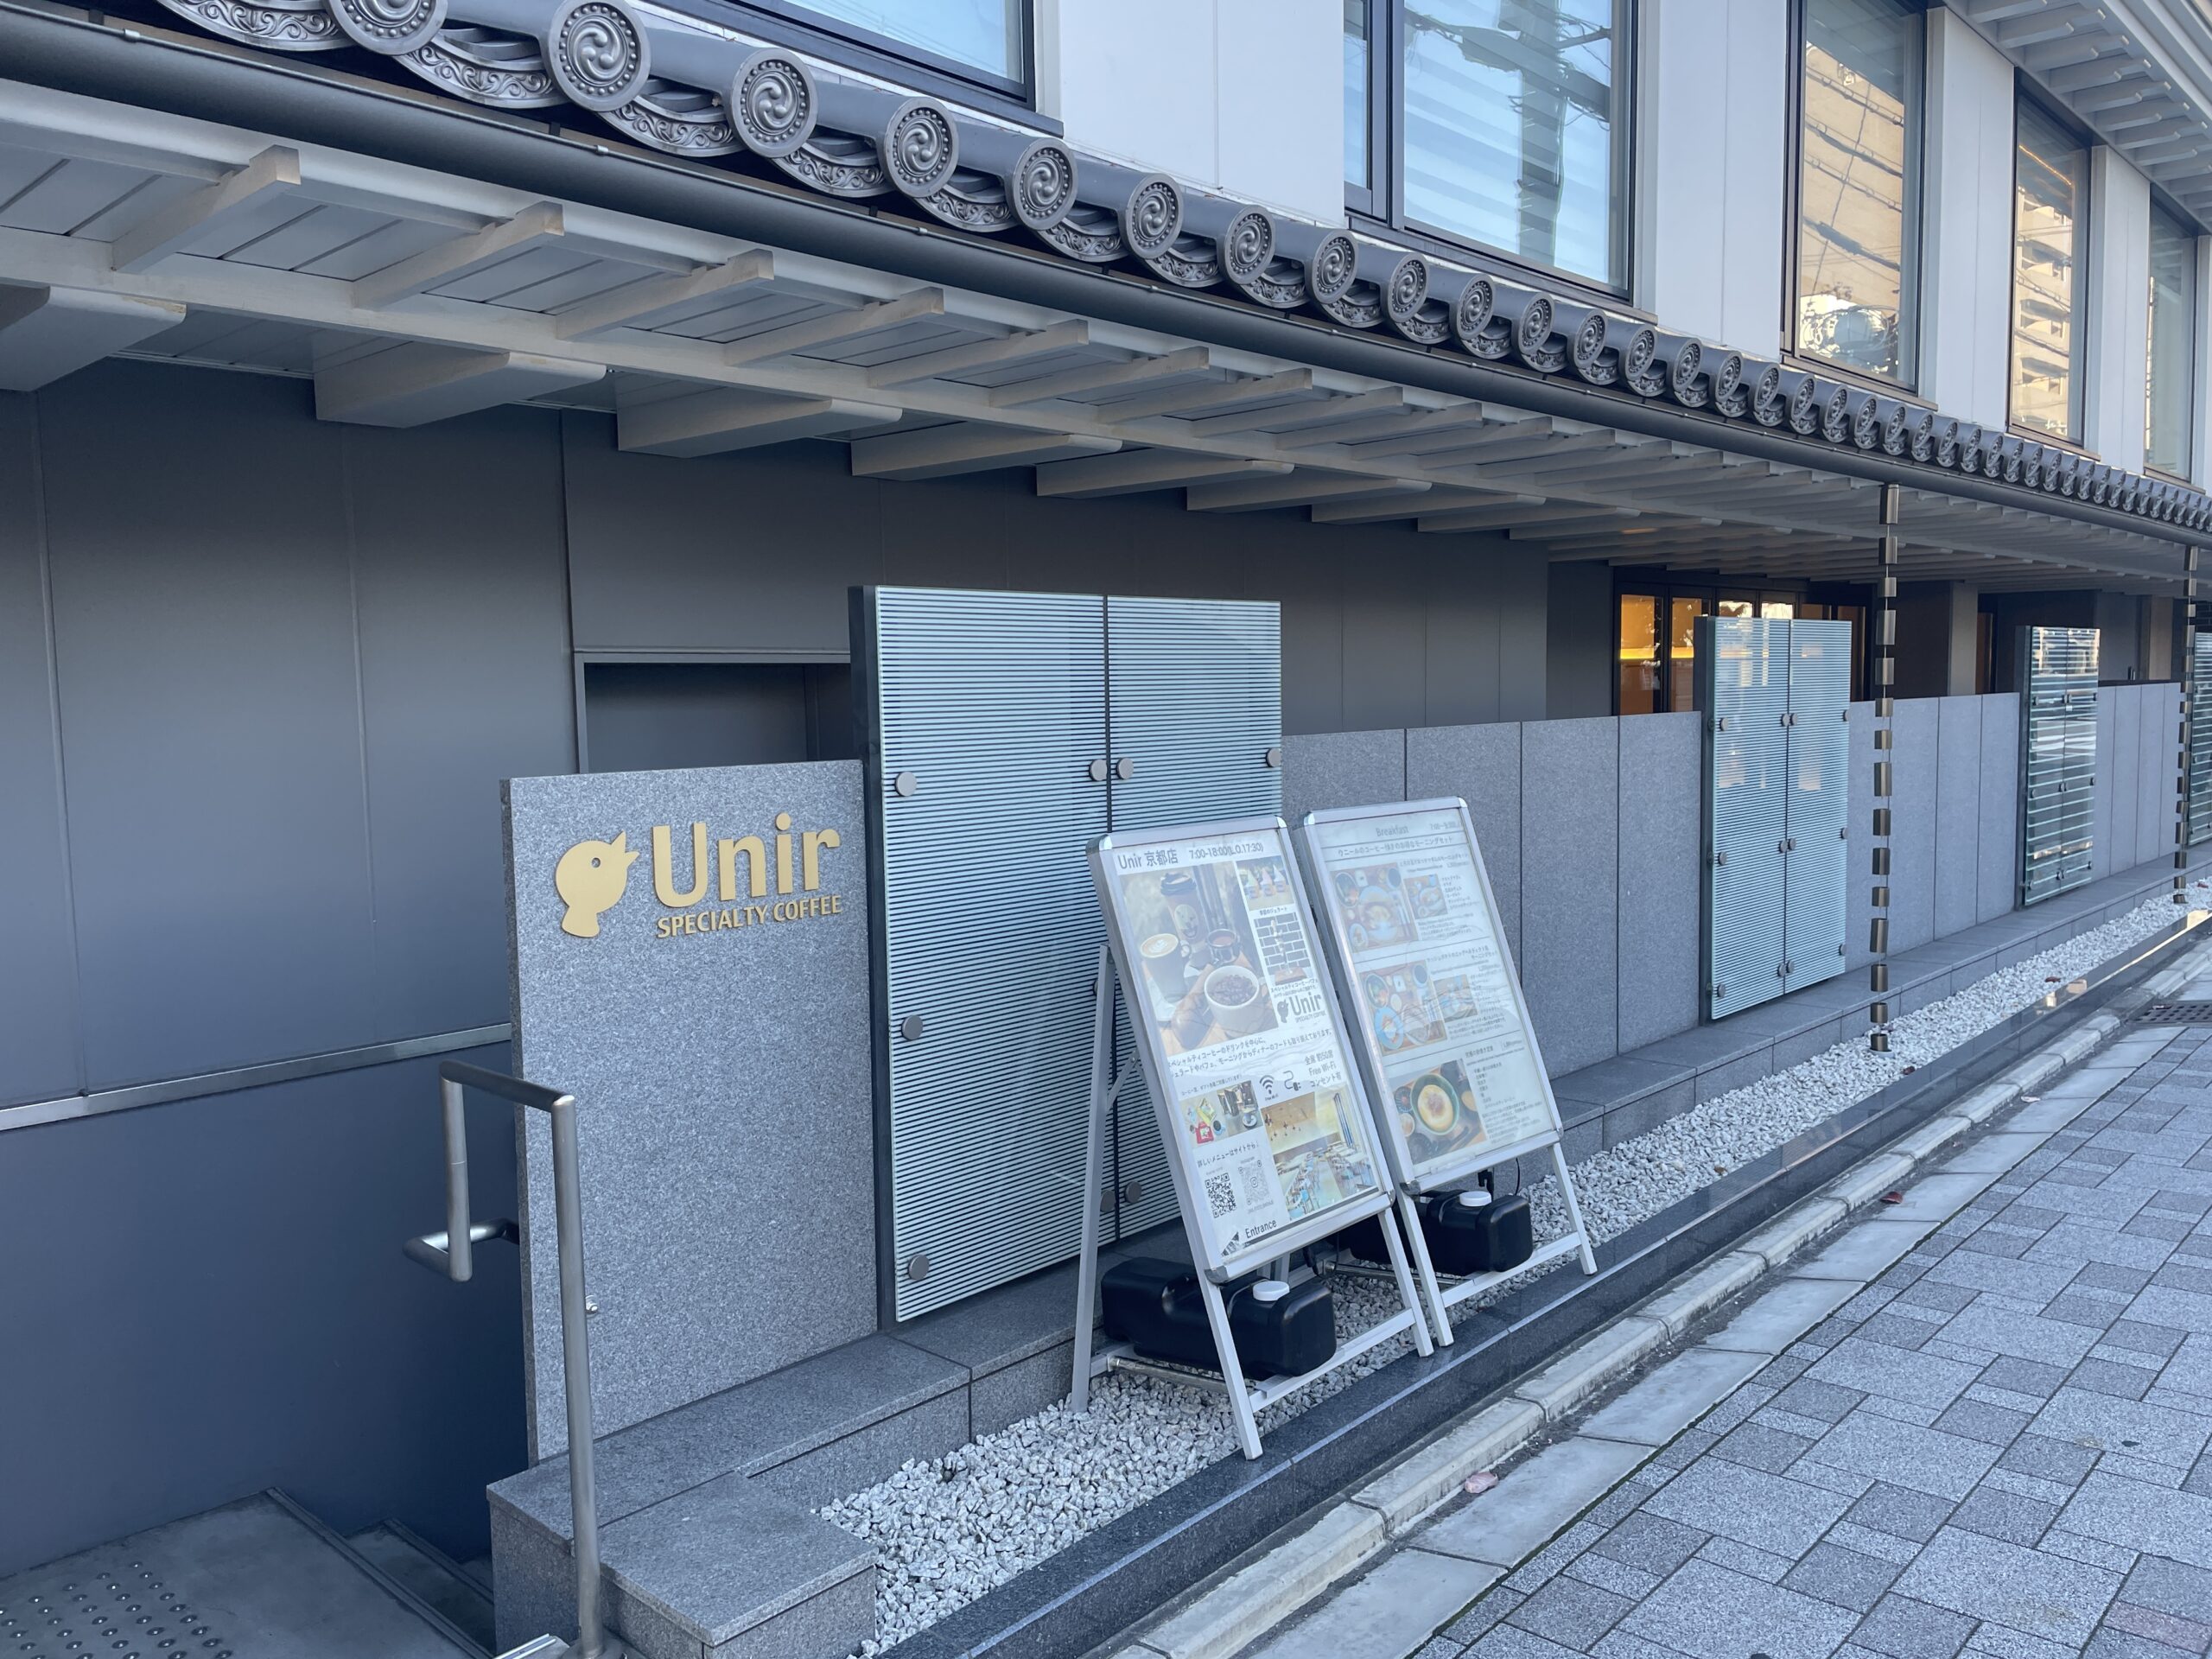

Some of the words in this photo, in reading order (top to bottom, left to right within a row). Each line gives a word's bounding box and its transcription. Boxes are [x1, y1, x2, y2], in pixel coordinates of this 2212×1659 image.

[1376, 825, 1409, 836] Breakfast
[652, 812, 841, 908] Unir
[1117, 853, 1141, 869] Unir
[1143, 849, 1177, 866] 京都店
[1188, 842, 1263, 859] 7:00-18:00(L.O.17:30)
[657, 904, 768, 938] SPECIALTY
[773, 895, 842, 922] COFFEE
[1289, 992, 1321, 1016] Unir
[1308, 1066, 1322, 1077] Free
[1323, 1063, 1337, 1075] Wi-Fi
[1244, 1219, 1277, 1239] Entrance
